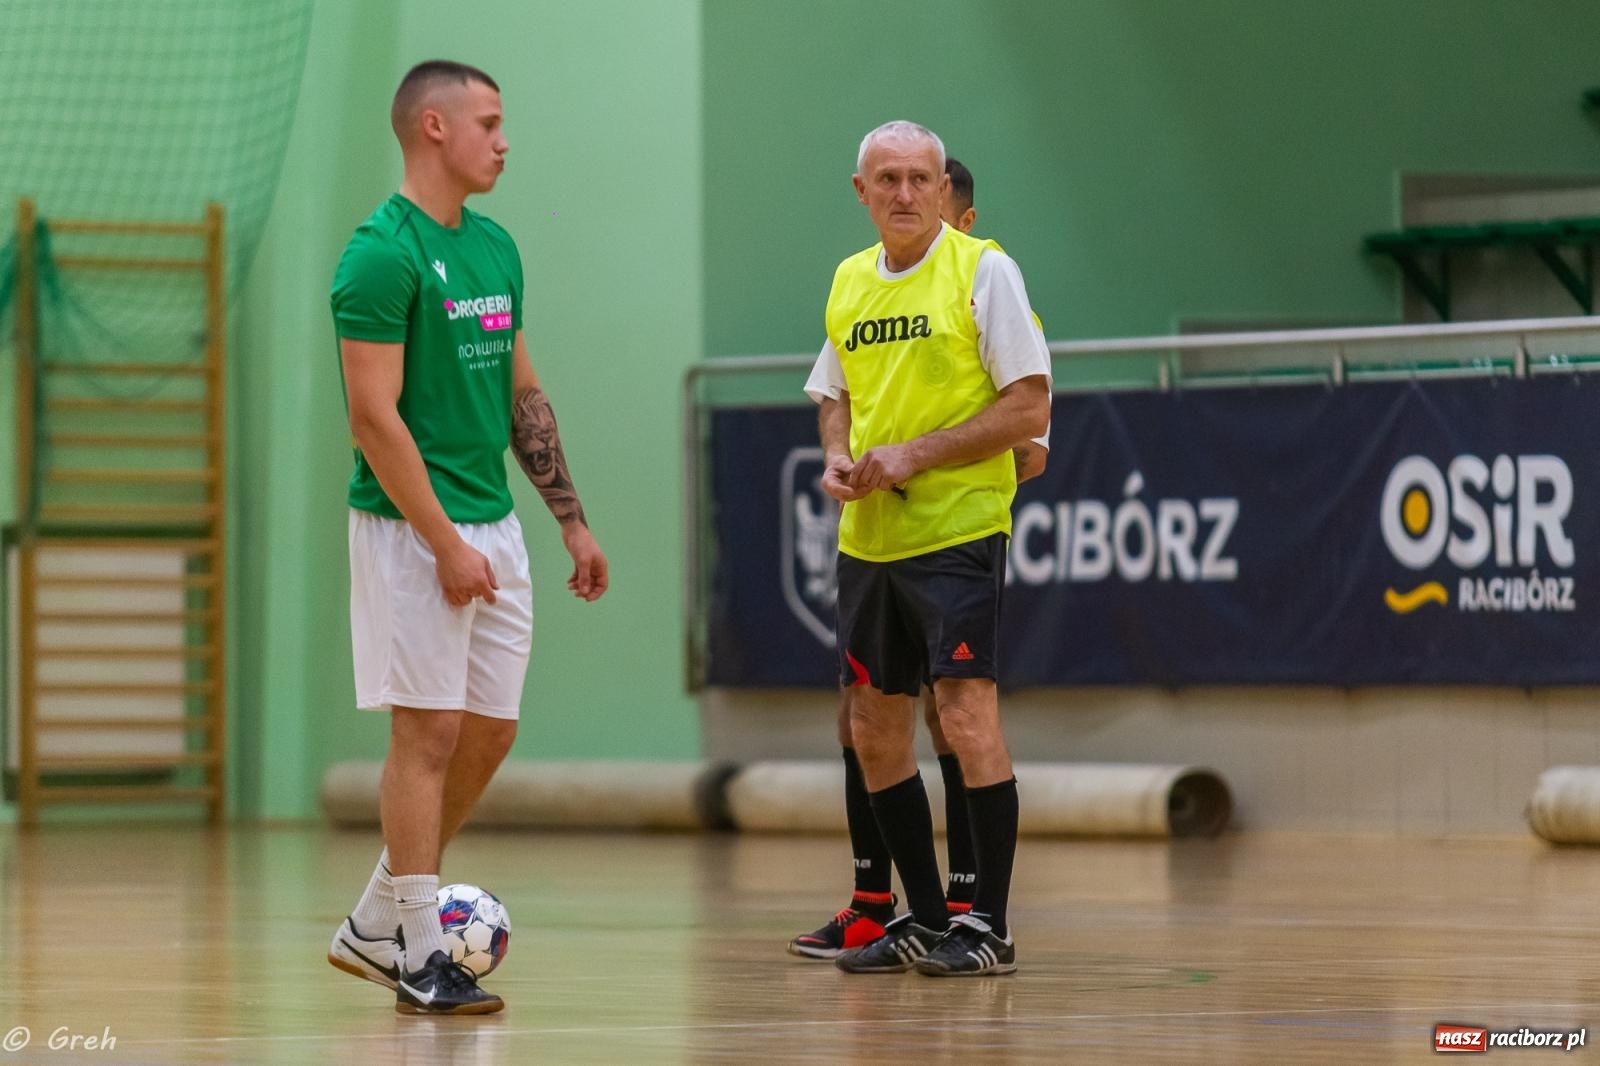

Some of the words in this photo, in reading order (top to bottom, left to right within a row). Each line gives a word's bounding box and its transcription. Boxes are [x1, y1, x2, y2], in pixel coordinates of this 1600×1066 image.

[485, 317, 494, 328] W
[1005, 470, 1240, 586] CIBÓRZ
[1458, 568, 1576, 612] RACIBÓRZ
